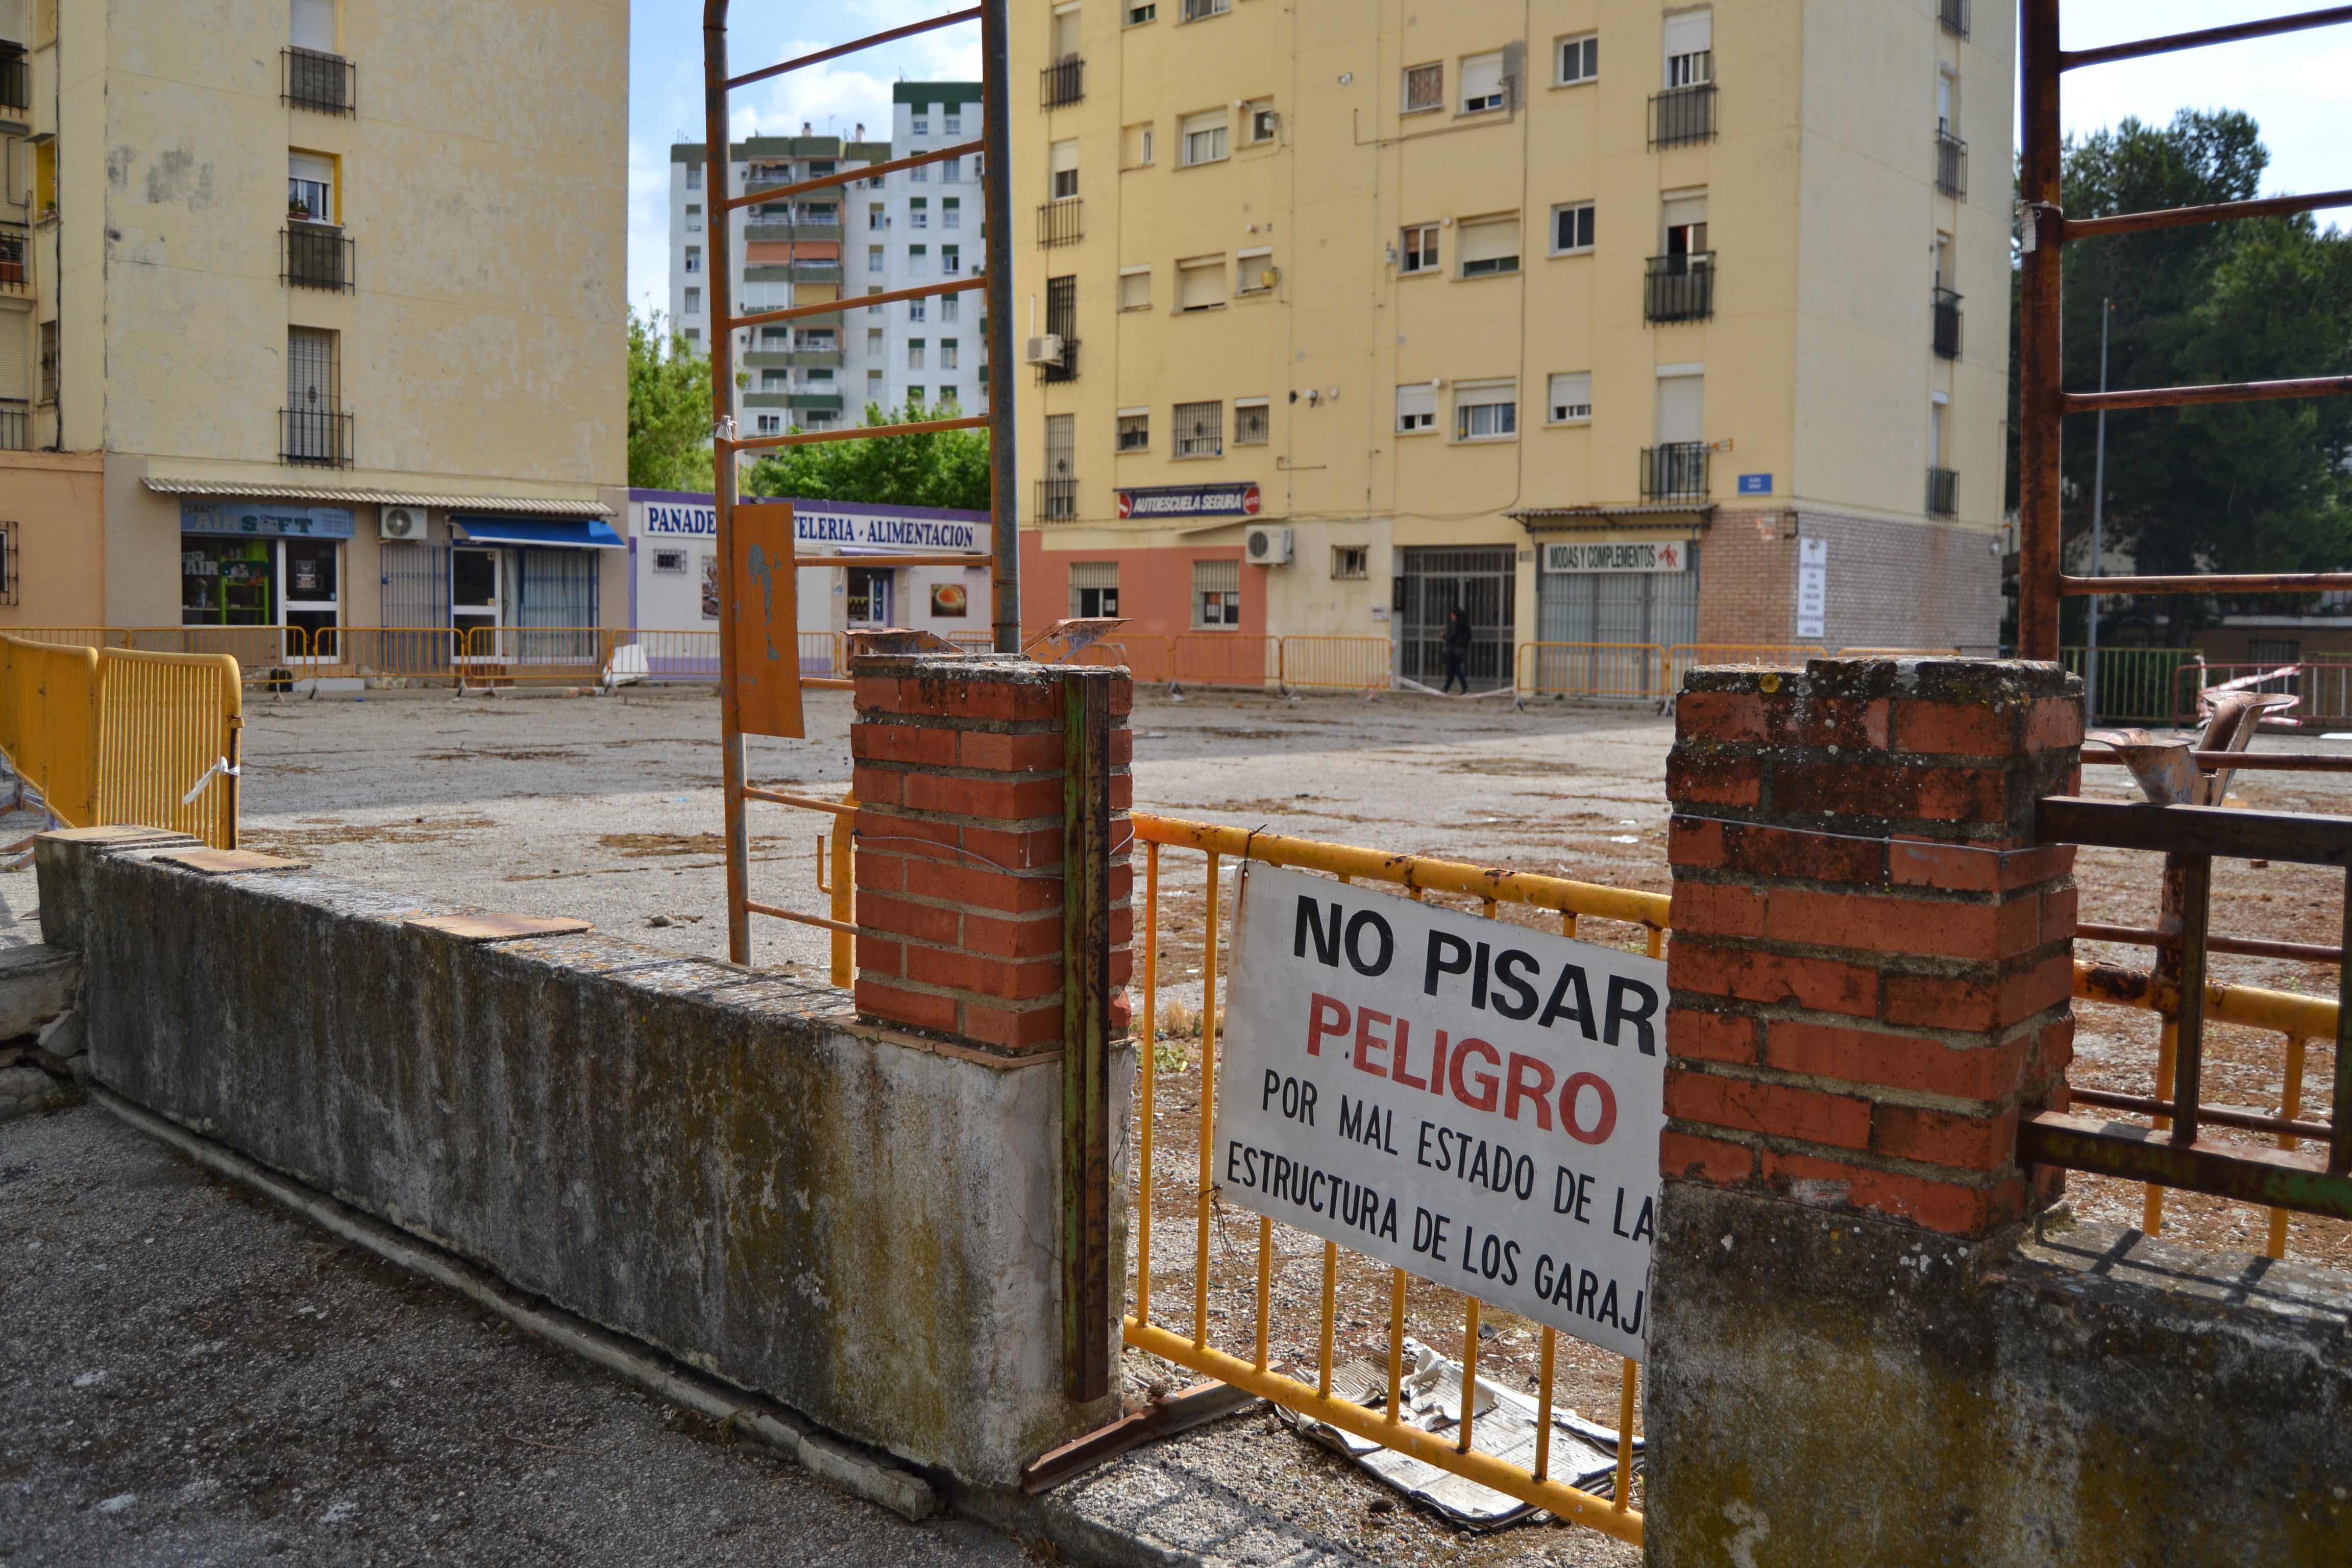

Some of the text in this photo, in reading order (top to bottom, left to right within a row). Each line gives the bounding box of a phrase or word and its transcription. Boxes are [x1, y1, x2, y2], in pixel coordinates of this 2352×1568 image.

[187, 505, 216, 513] CRAZY
[648, 507, 716, 534] PANADE
[794, 515, 854, 542] ELERIA
[867, 520, 973, 548] ALIMENTACION
[1134, 494, 1241, 512] AUTOESCUELA SEGURA
[1550, 544, 1656, 569] MODAS Y COMPLEMENTOS
[1293, 894, 1659, 1057] NO PISAR
[1306, 992, 1618, 1145] PELIGRO
[1262, 1068, 1653, 1246] POR MAL ESTADO DE LA
[1227, 1140, 1646, 1339] ESTRUCTURA DE LOS GARAJ
